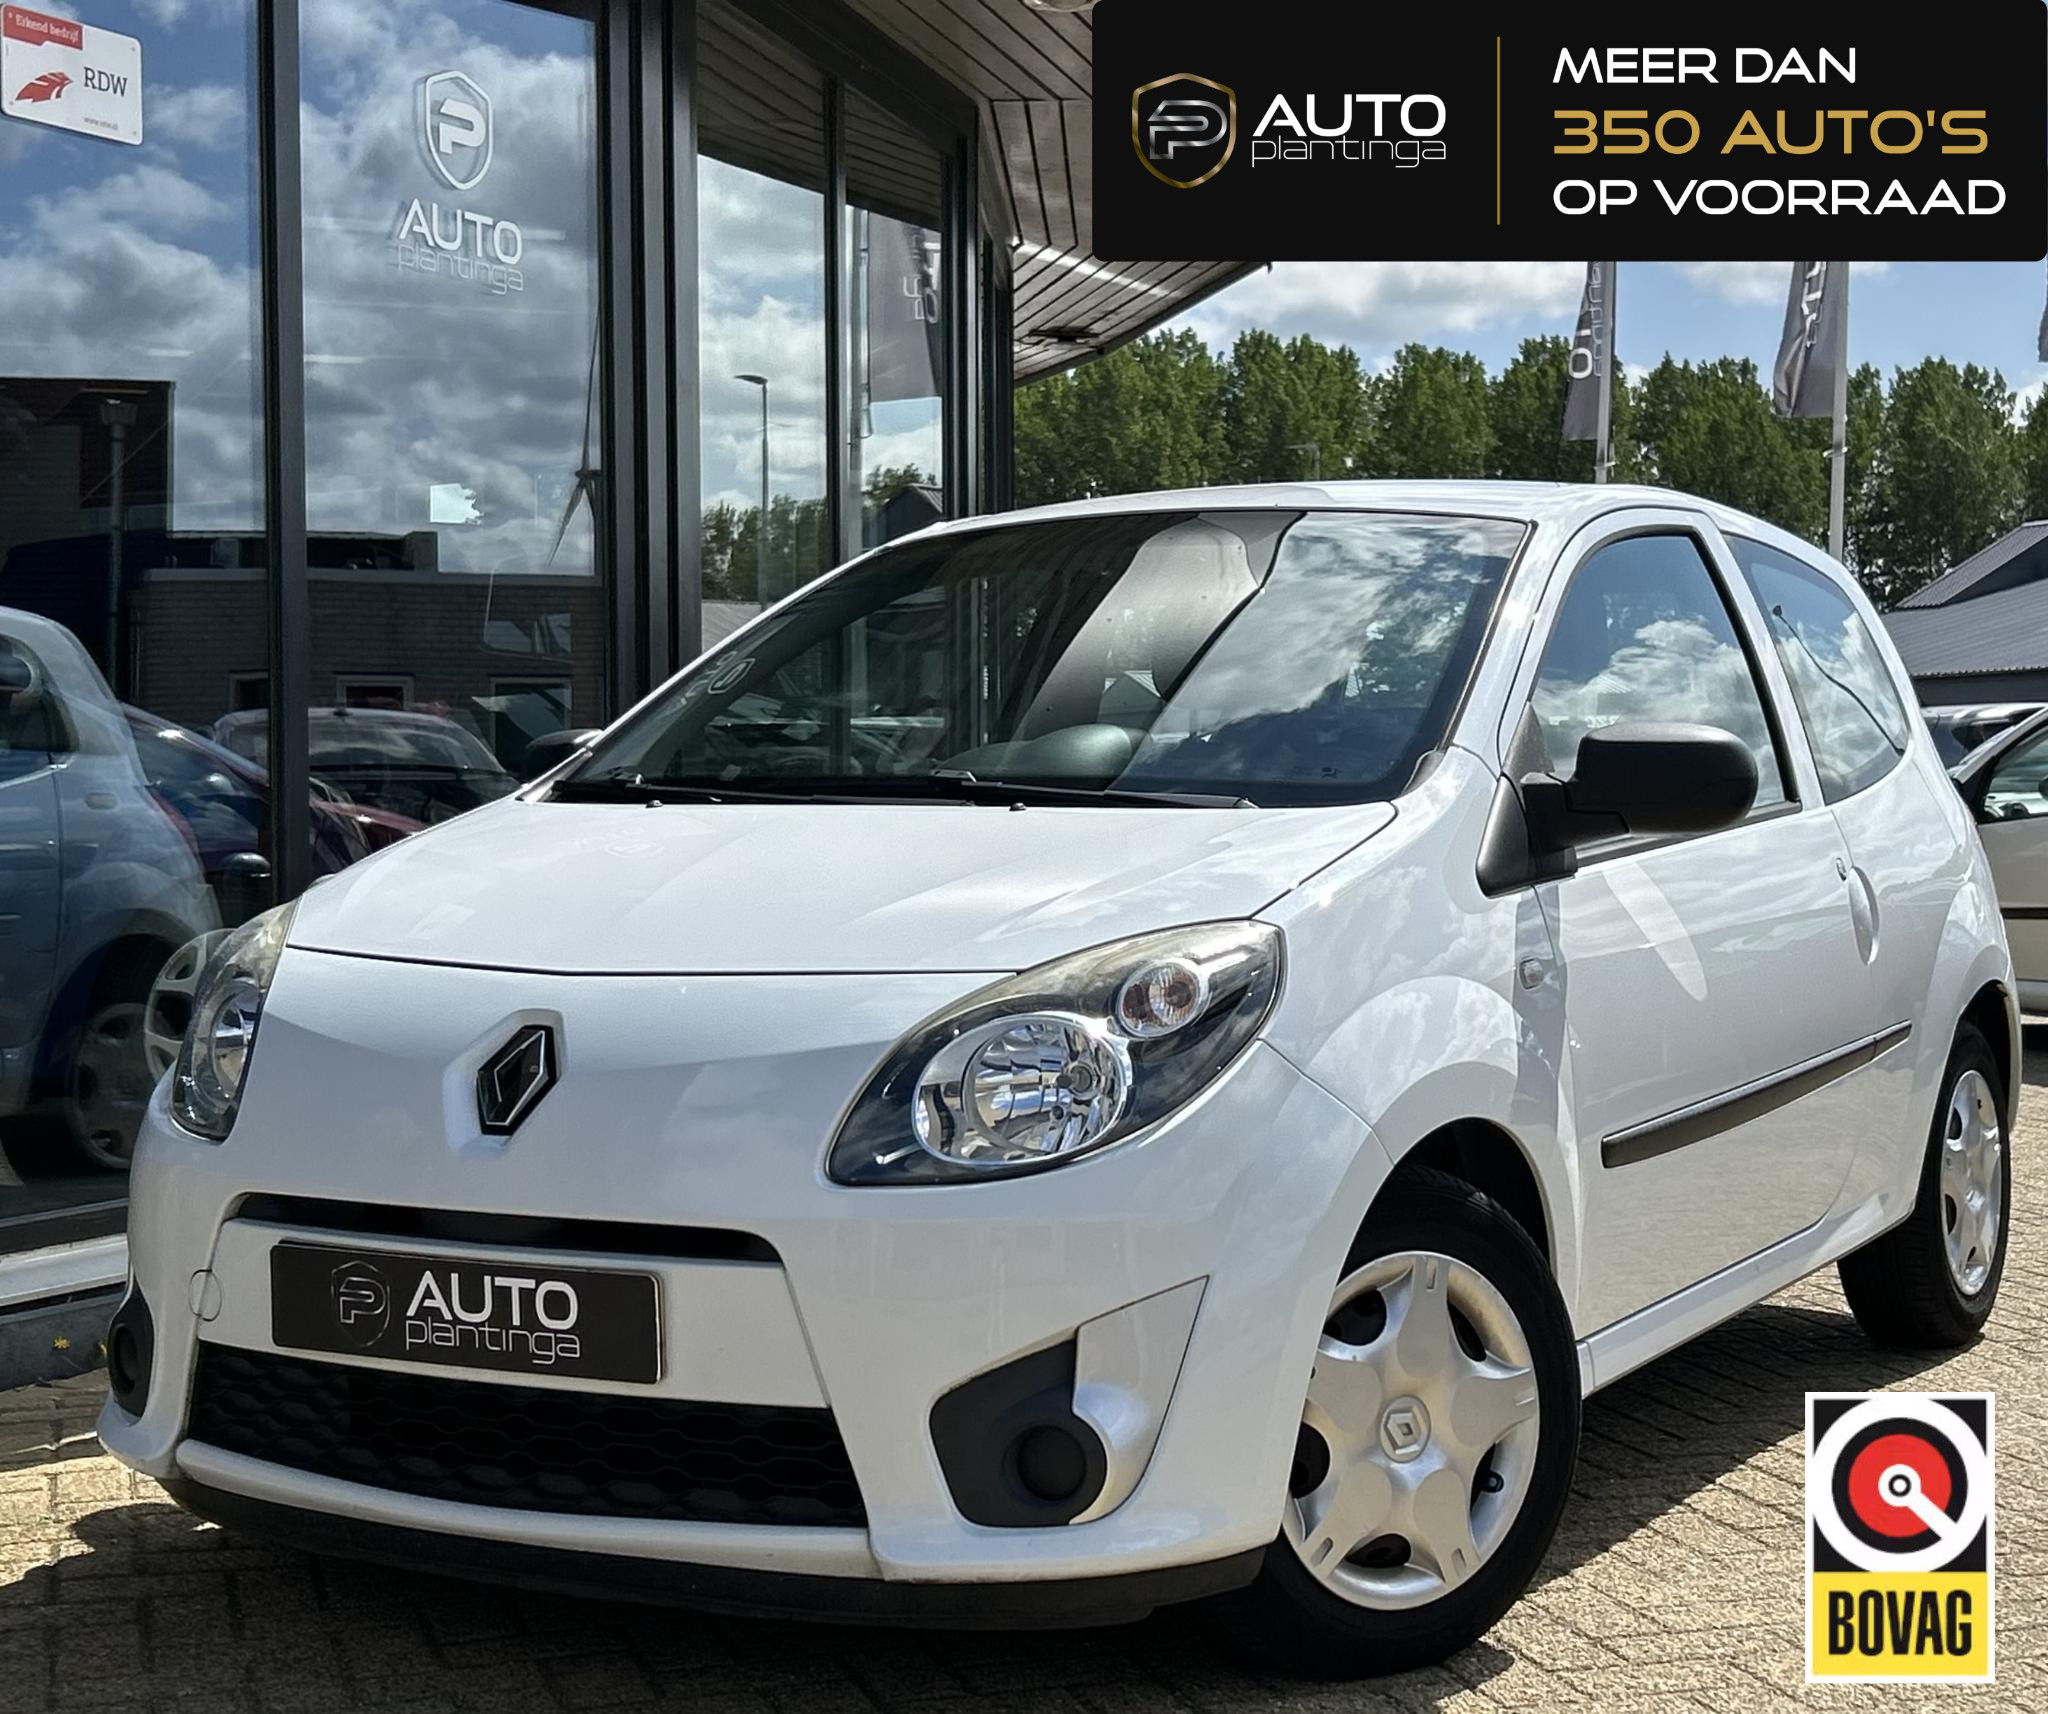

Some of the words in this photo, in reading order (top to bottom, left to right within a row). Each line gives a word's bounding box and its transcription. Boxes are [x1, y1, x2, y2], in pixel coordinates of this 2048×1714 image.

[83, 66, 128, 97] RDW
[399, 197, 523, 266] AUTO
[398, 243, 525, 296] plantinga
[406, 1270, 579, 1330] AUTO
[405, 1316, 581, 1365] plantinga
